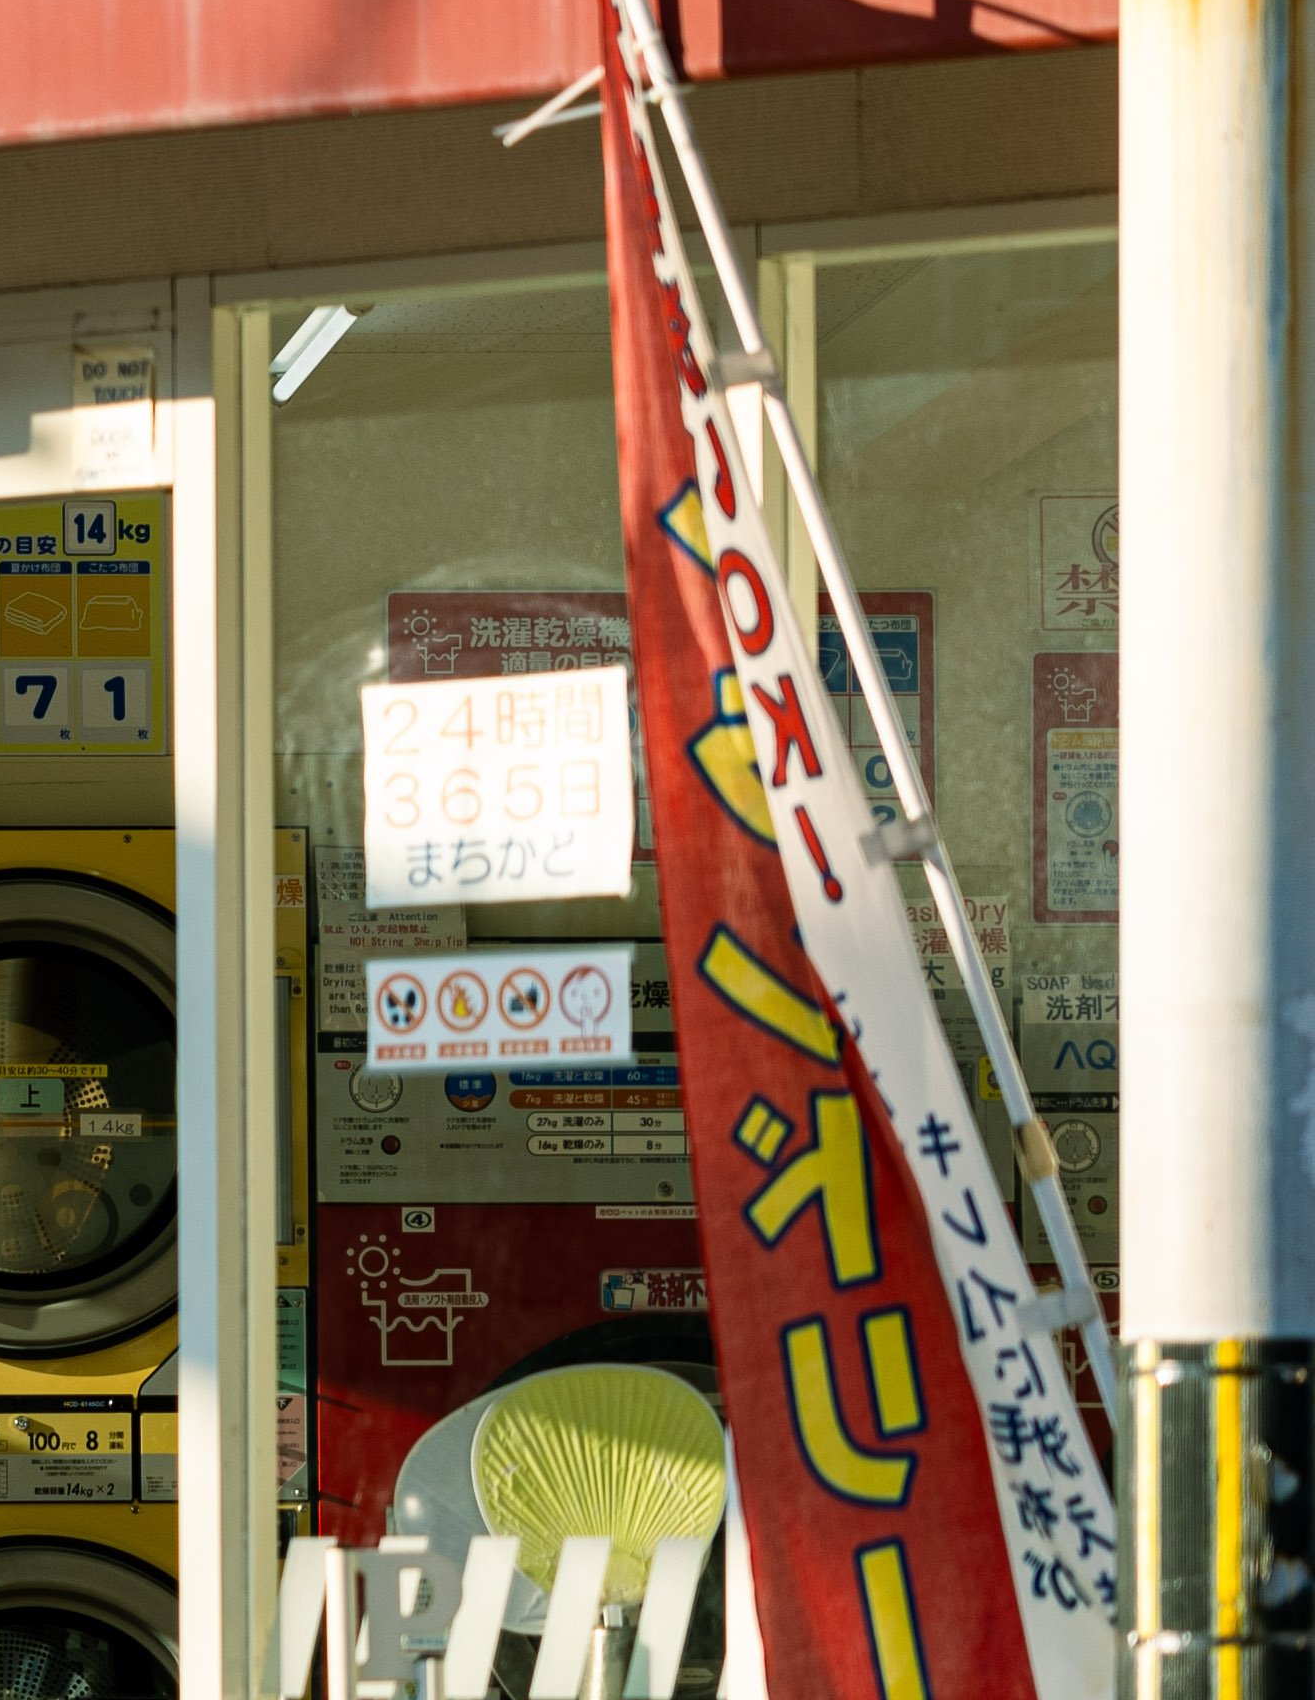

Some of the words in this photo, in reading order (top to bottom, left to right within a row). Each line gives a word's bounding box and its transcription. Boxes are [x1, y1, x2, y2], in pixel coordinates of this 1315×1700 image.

[83, 363, 106, 381] DO
[117, 360, 150, 377] NOT
[73, 512, 106, 545] 14
[118, 519, 151, 544] kg
[10, 563, 61, 575] 夏かけ布団
[88, 563, 140, 575] こたつ布団
[15, 675, 58, 720] 7
[104, 676, 126, 721] 1
[383, 683, 603, 755] 24時間
[60, 730, 70, 741] 枚
[137, 730, 148, 740] 枚
[384, 759, 601, 829] 365日
[407, 832, 575, 888] まちかど
[276, 879, 304, 905] 燥
[389, 913, 438, 922] Attention
[371, 937, 404, 948] String
[1027, 976, 1070, 991] SOAP
[329, 1004, 351, 1014] than
[553, 1069, 604, 1083] 洗濯と乾燥
[459, 1078, 483, 1090] 標準
[20, 1083, 41, 1108] 上
[553, 1092, 604, 1105] 洗濯と乾燥
[537, 1117, 558, 1129] 27kg
[563, 1115, 605, 1128] 洗濯のみ
[537, 1140, 558, 1152] 16kg
[563, 1138, 605, 1151] 乾燥のみ
[86, 1431, 98, 1450] 8
